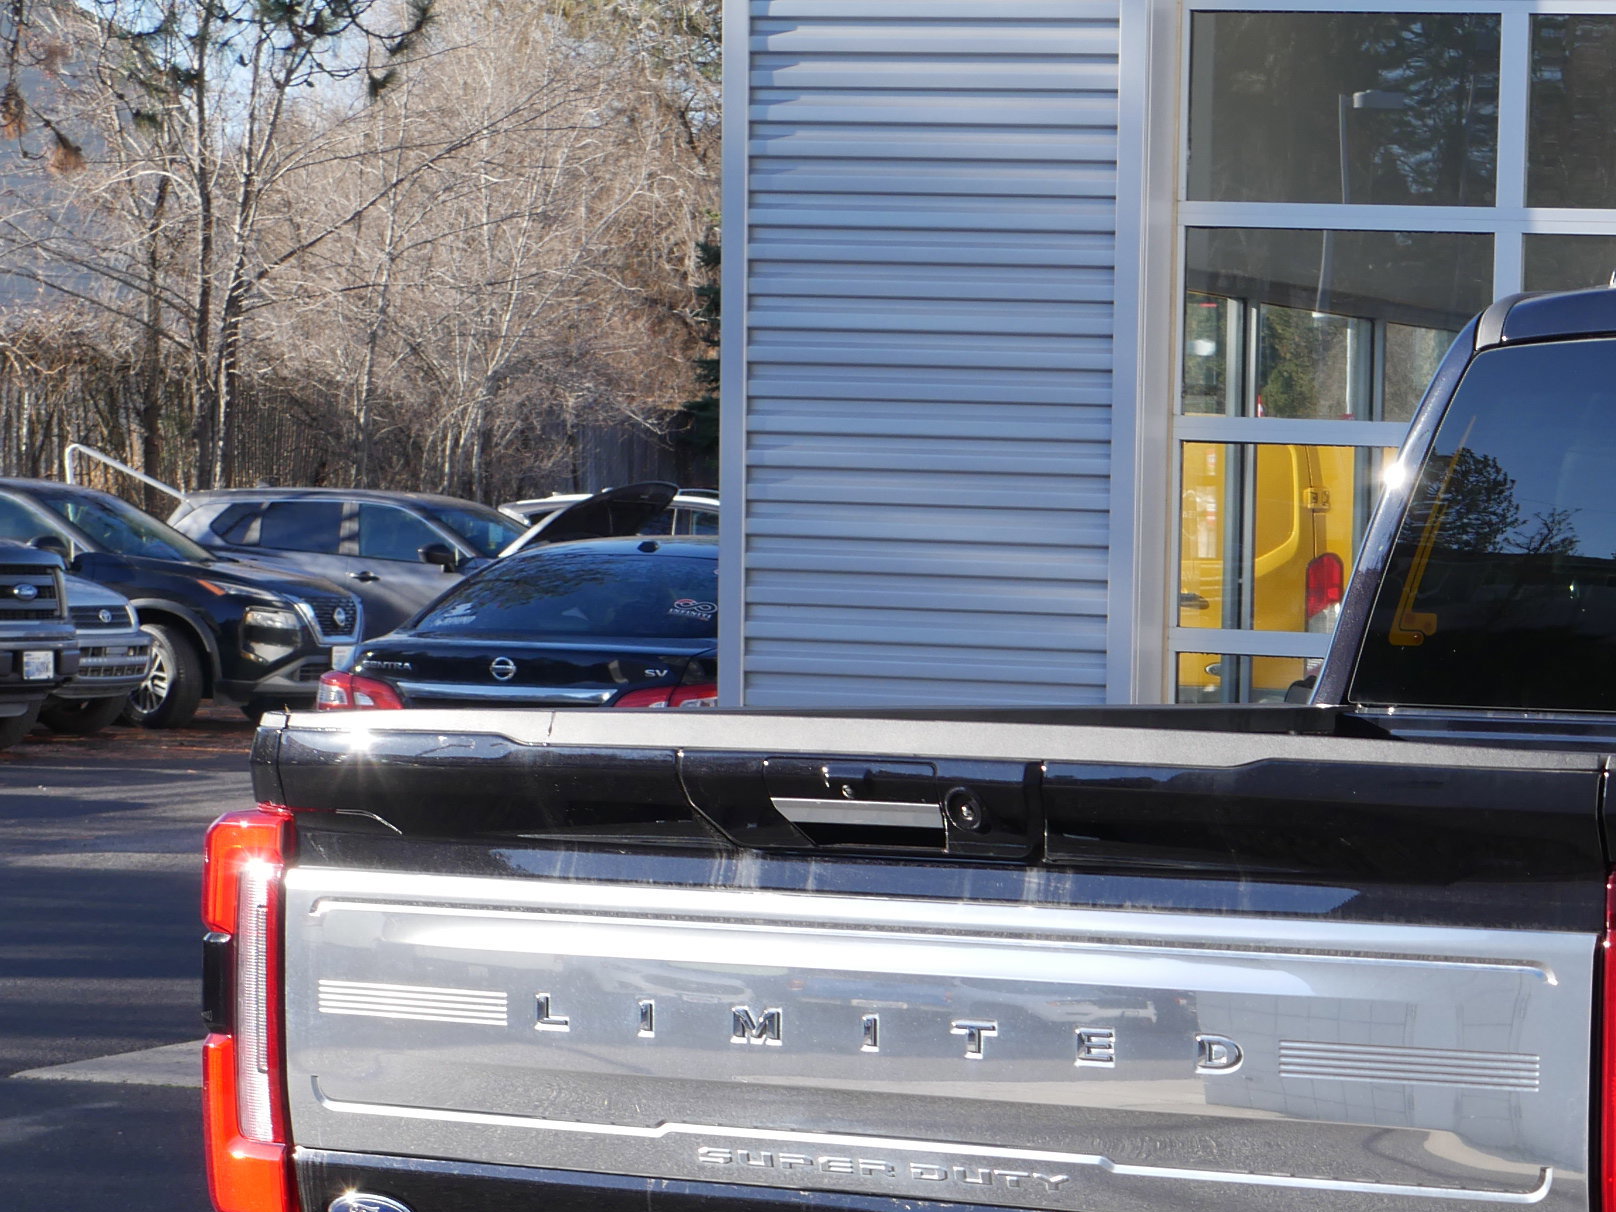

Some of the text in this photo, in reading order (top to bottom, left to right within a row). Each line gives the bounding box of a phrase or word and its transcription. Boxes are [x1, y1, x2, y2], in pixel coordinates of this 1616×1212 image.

[362, 660, 412, 671] SENTRA
[644, 669, 668, 677] SV
[534, 991, 1245, 1076] LIMITED
[697, 1145, 1071, 1192] SUPER DUTY
